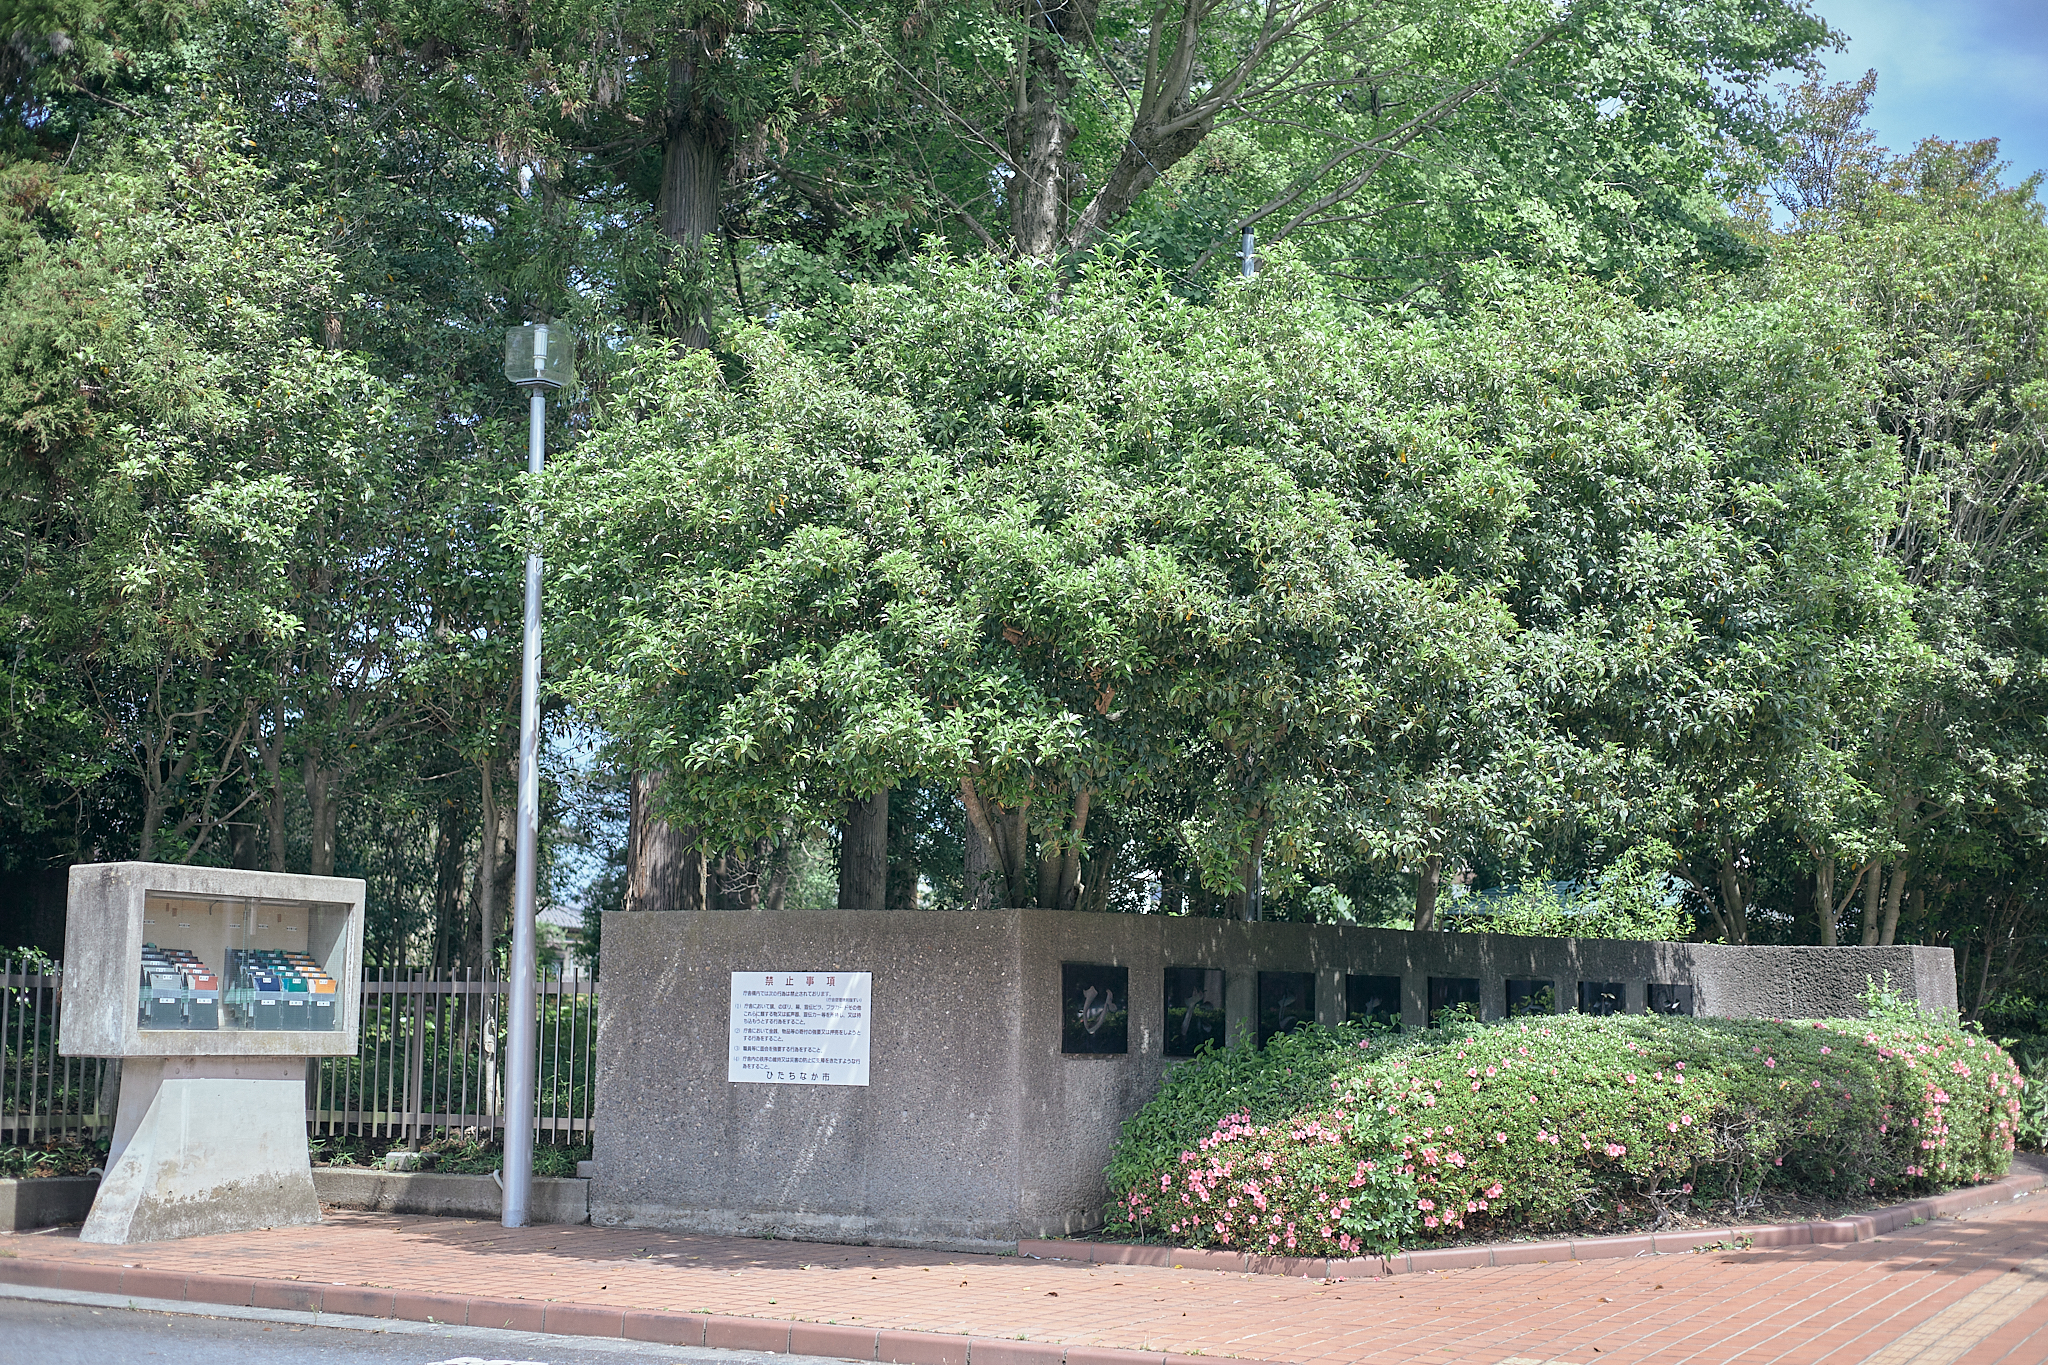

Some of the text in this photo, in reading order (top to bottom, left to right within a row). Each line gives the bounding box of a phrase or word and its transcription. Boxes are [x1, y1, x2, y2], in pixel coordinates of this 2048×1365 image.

[764, 976, 836, 987] 禁止事項
[766, 1071, 830, 1082] ひたちなか市
